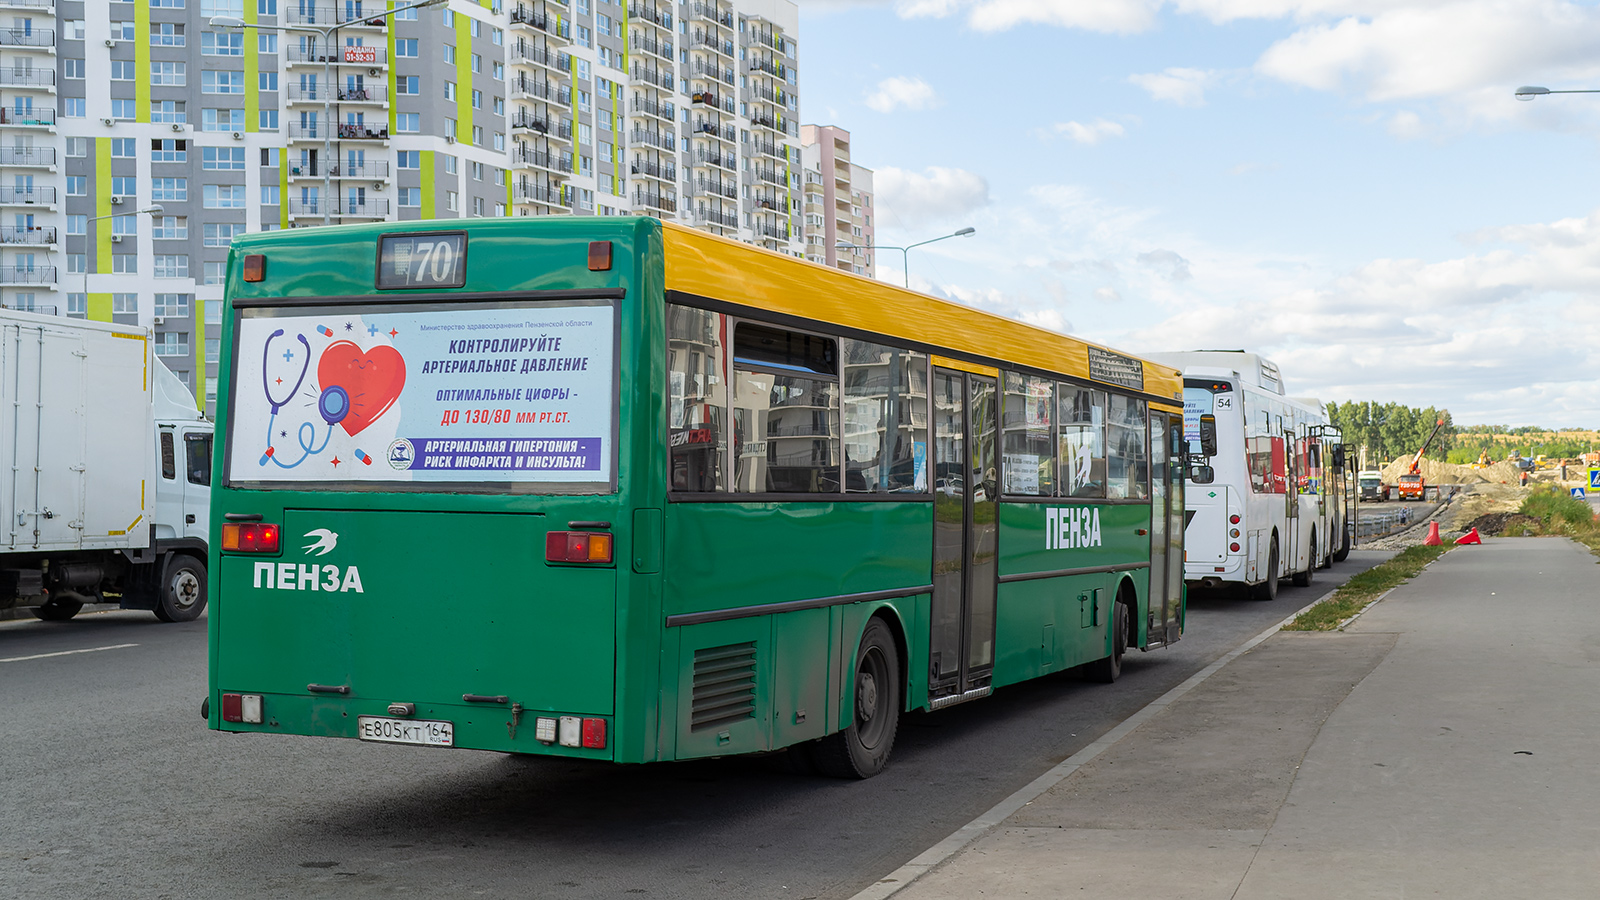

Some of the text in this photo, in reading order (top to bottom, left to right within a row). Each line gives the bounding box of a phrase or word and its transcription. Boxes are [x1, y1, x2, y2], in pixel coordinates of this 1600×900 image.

[346, 53, 374, 61] 51-52-53
[415, 241, 452, 282] 70
[467, 322, 523, 331] здравоохранения
[449, 333, 562, 354] КОНТРОЛИРУЙТЕ
[422, 357, 589, 375] АРТЕРИАЛЬНОЕ ДАВЛЕНИЕ
[436, 388, 522, 401] ОПТИМАЛЬНЫЕ
[525, 388, 570, 402] ЦИФРЫ
[1217, 398, 1231, 408] 54
[440, 409, 571, 426] ДО 130/80 ММ РТ.СТ.
[424, 440, 506, 453] АРТЕРИАЛЬНАЯ
[509, 440, 578, 452] ГИПЕРТОНИЯ
[424, 455, 587, 468] РИСК ИНФАРКТА И ИНСУЛЬТА!
[1045, 506, 1102, 550] ПЕНЗА
[253, 561, 364, 593] ПЕНЗА
[425, 722, 448, 738] 164
